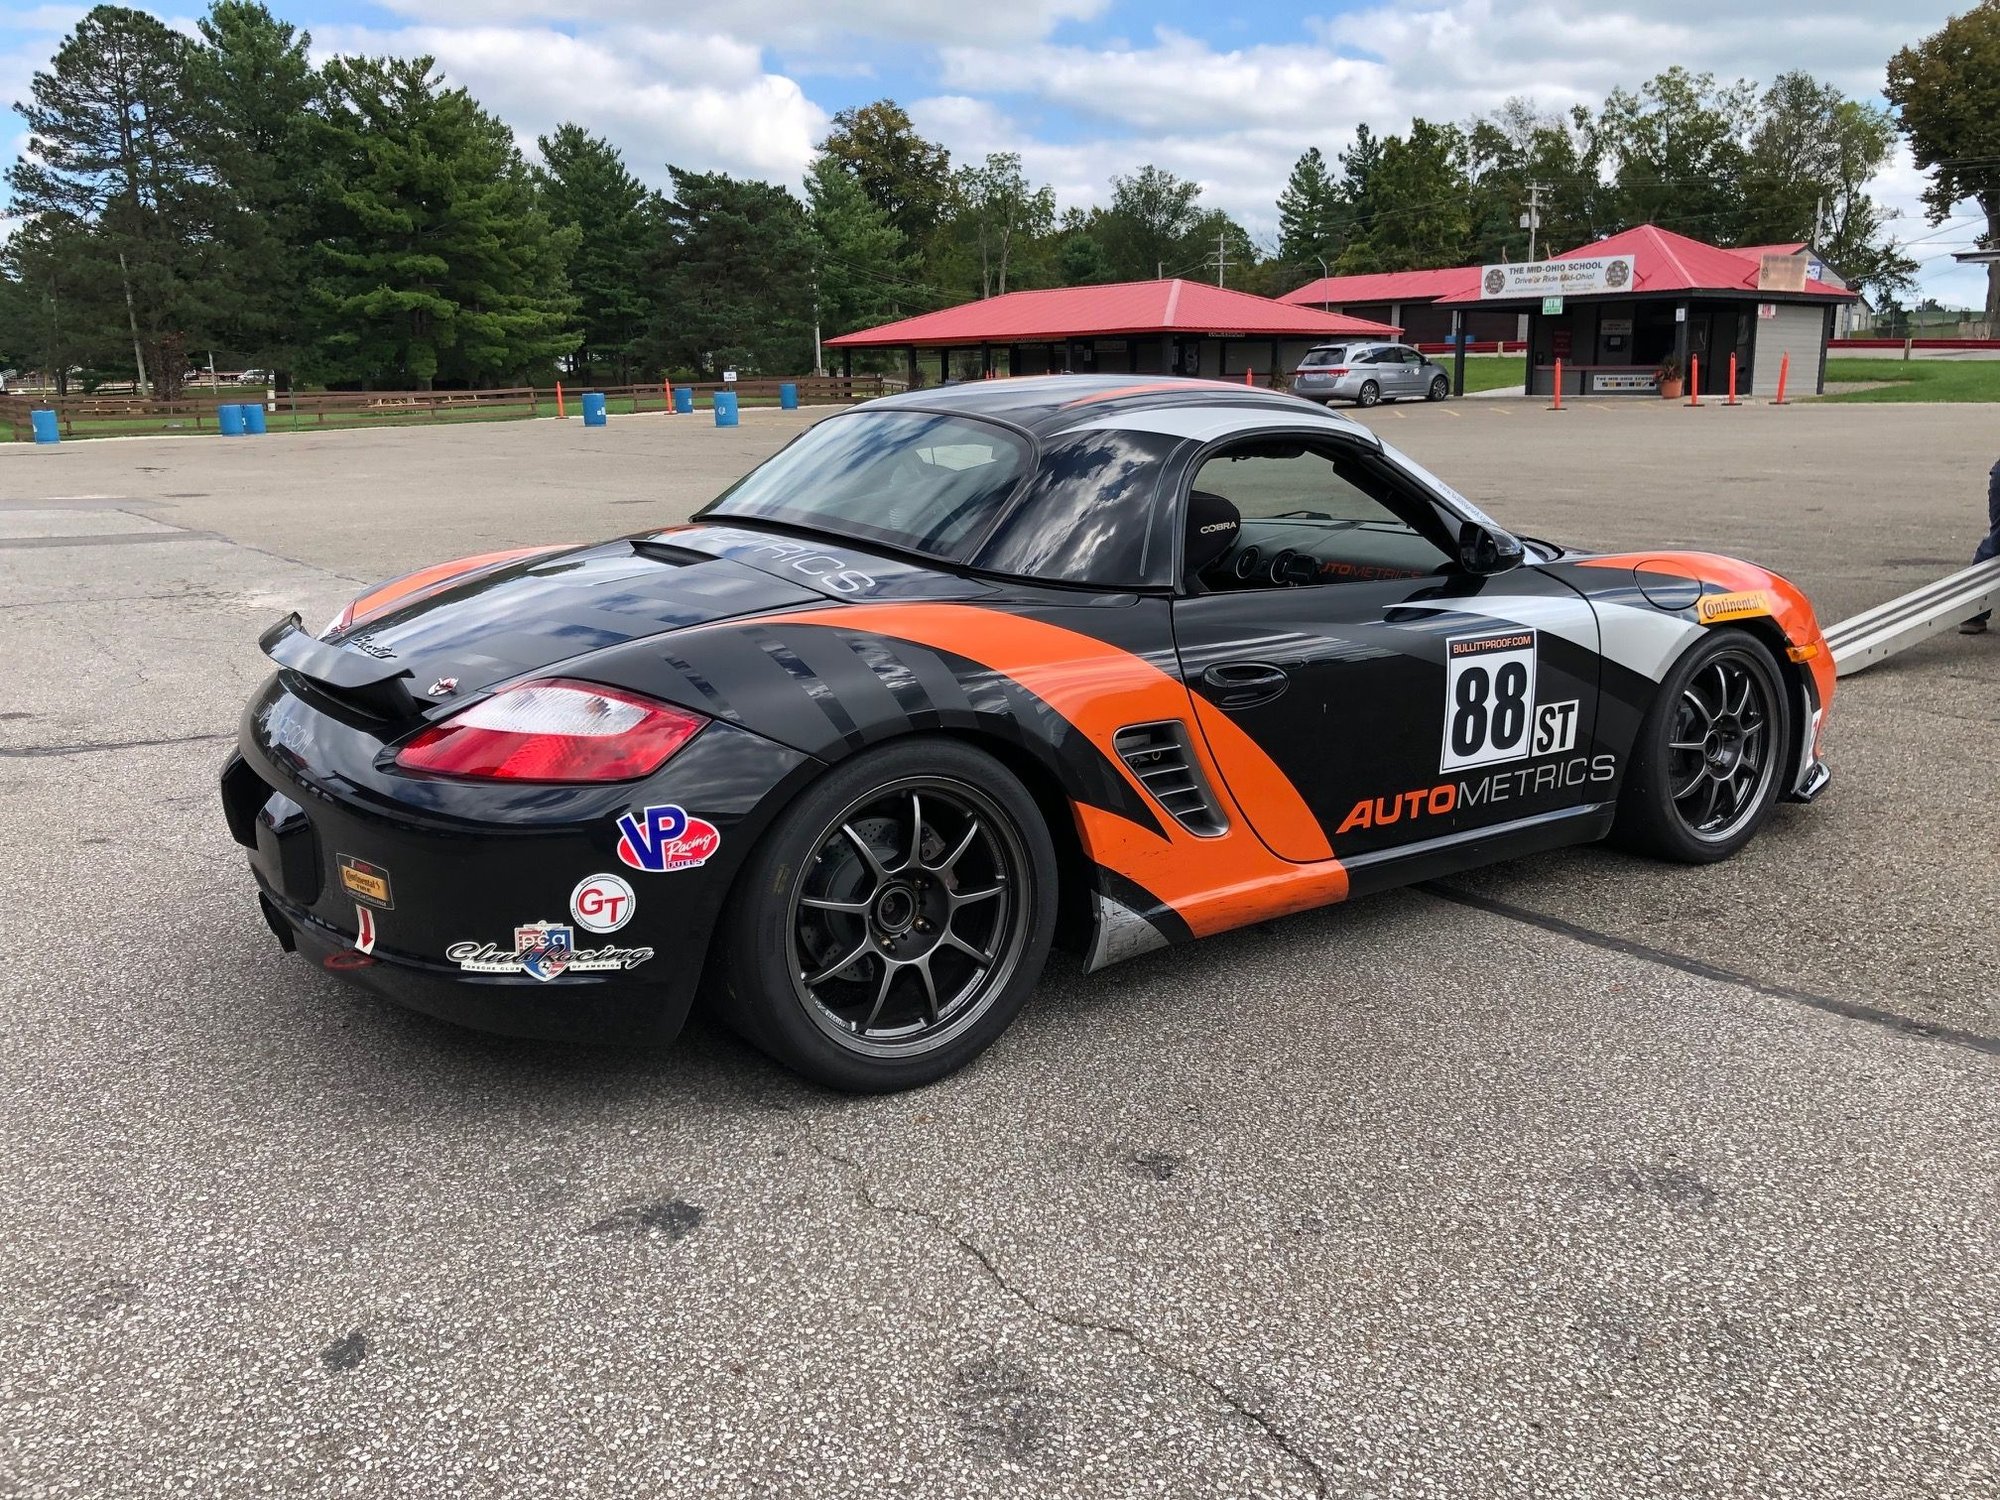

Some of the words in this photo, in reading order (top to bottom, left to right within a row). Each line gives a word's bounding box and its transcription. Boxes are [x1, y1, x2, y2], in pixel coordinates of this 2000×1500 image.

[1509, 267, 1524, 276] THE
[1526, 263, 1566, 273] MID-OHIO
[1568, 261, 1603, 271] SCHOOL
[1515, 275, 1532, 284] Drive
[1533, 276, 1541, 284] or
[1543, 275, 1558, 283] Ride
[1560, 272, 1595, 282] Mid-Ohio!
[1200, 520, 1237, 535] COBRA
[1702, 596, 1760, 619] Continental
[1453, 635, 1531, 654] BULLITTPROOF.COM
[1451, 661, 1528, 758] 88
[1536, 703, 1576, 753] ST
[1335, 754, 1616, 835] AUTOMETRICS
[618, 805, 687, 870] VP
[666, 833, 717, 861] Racing
[667, 858, 703, 869] FUELS
[578, 888, 626, 923] GT
[521, 930, 566, 948] pca
[446, 942, 538, 965] Club
[534, 943, 654, 969] Racing
